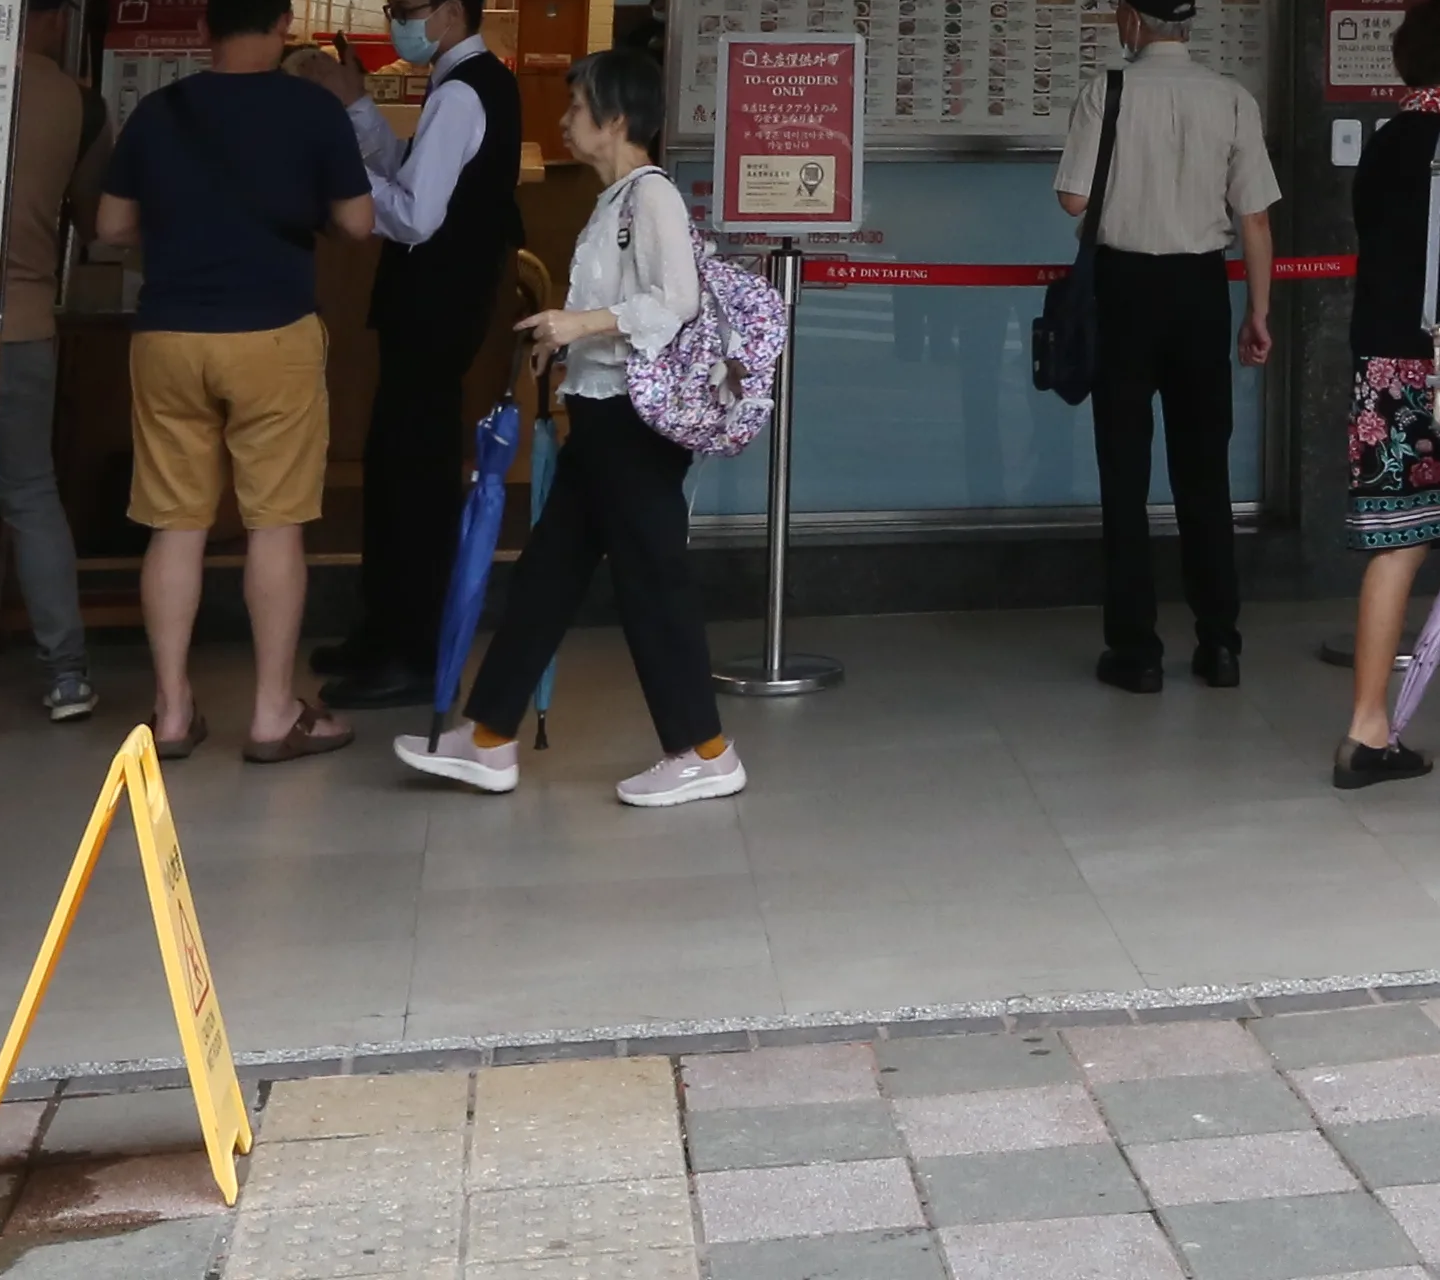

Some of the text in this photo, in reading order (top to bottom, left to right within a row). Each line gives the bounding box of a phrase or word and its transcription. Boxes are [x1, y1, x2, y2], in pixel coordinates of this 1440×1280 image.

[744, 75, 838, 85] TO-GO ORDERS
[772, 86, 806, 96] ONLY
[1276, 261, 1340, 272] DIN TAI FUNG
[860, 268, 880, 277] DIN
[881, 268, 897, 278] TAI
[899, 269, 928, 279] FUNG
